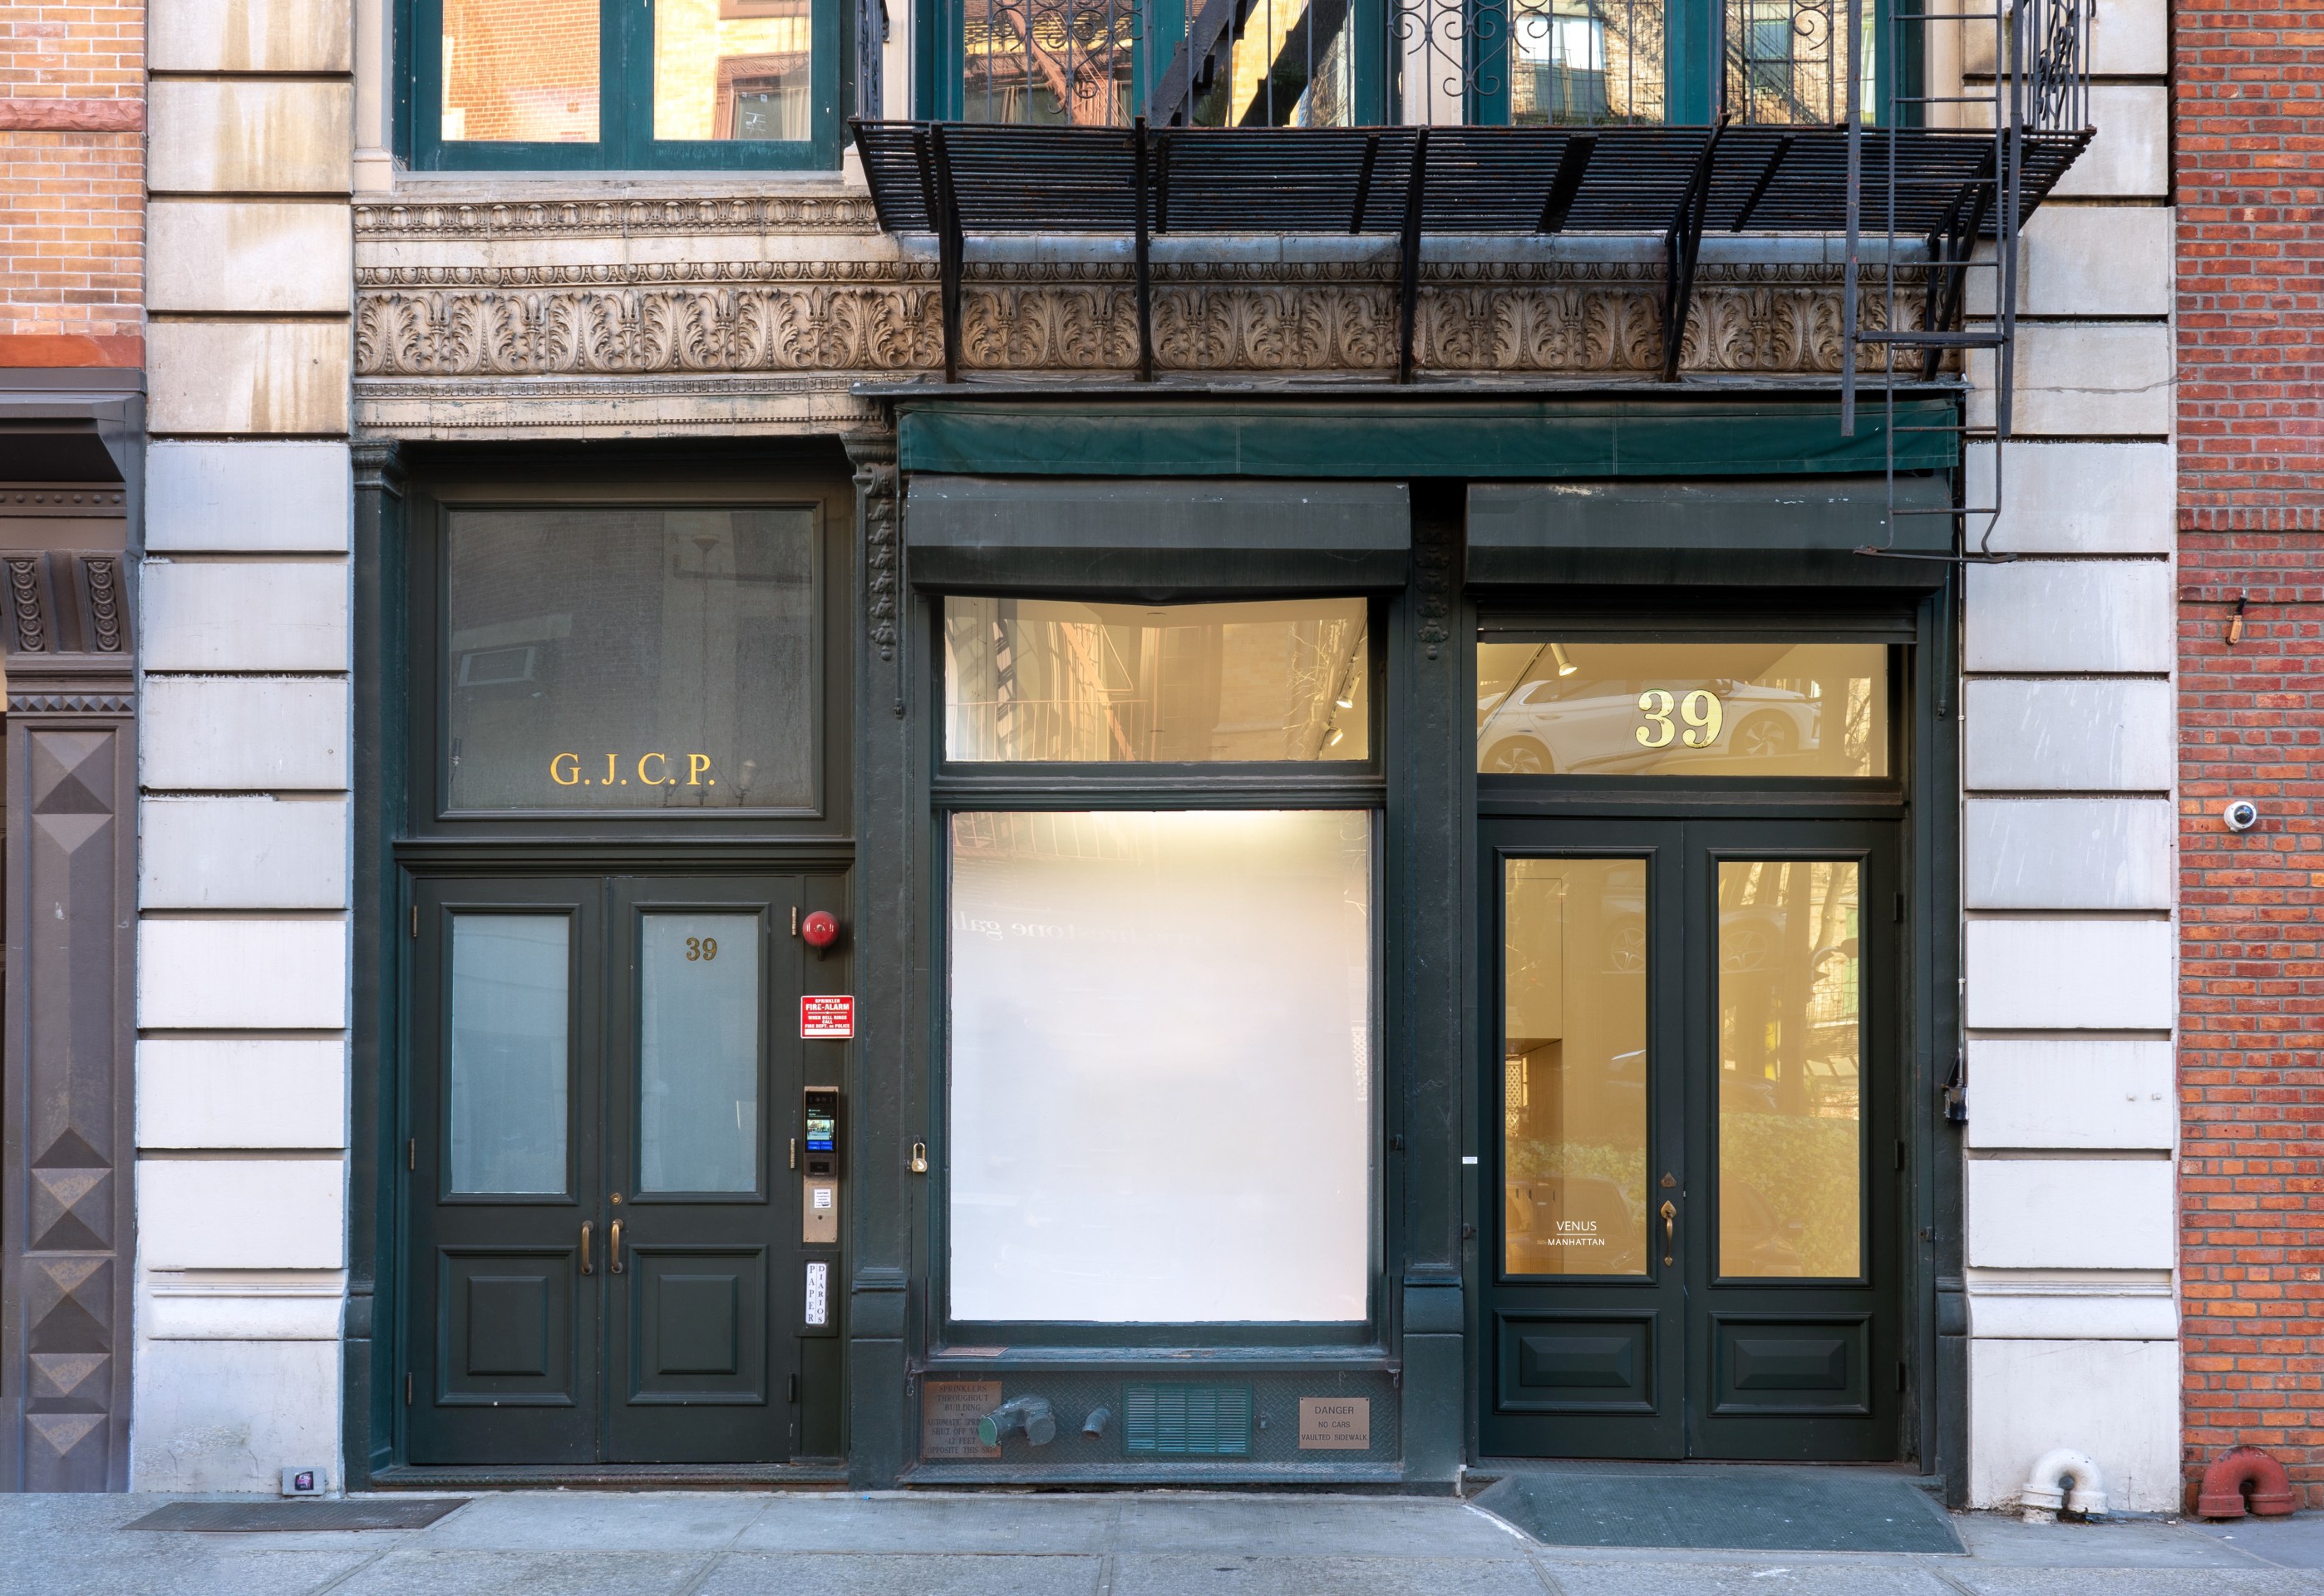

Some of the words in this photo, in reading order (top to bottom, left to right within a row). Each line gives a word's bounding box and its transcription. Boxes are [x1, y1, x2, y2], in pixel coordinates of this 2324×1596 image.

[1635, 688, 1724, 749] 39
[549, 752, 591, 786] G.
[601, 753, 628, 786] J.
[638, 752, 677, 786] C.
[686, 753, 716, 786] P.
[686, 937, 718, 962] 39
[1556, 1220, 1597, 1231] VENUS
[1548, 1238, 1605, 1246] MANHATTAN
